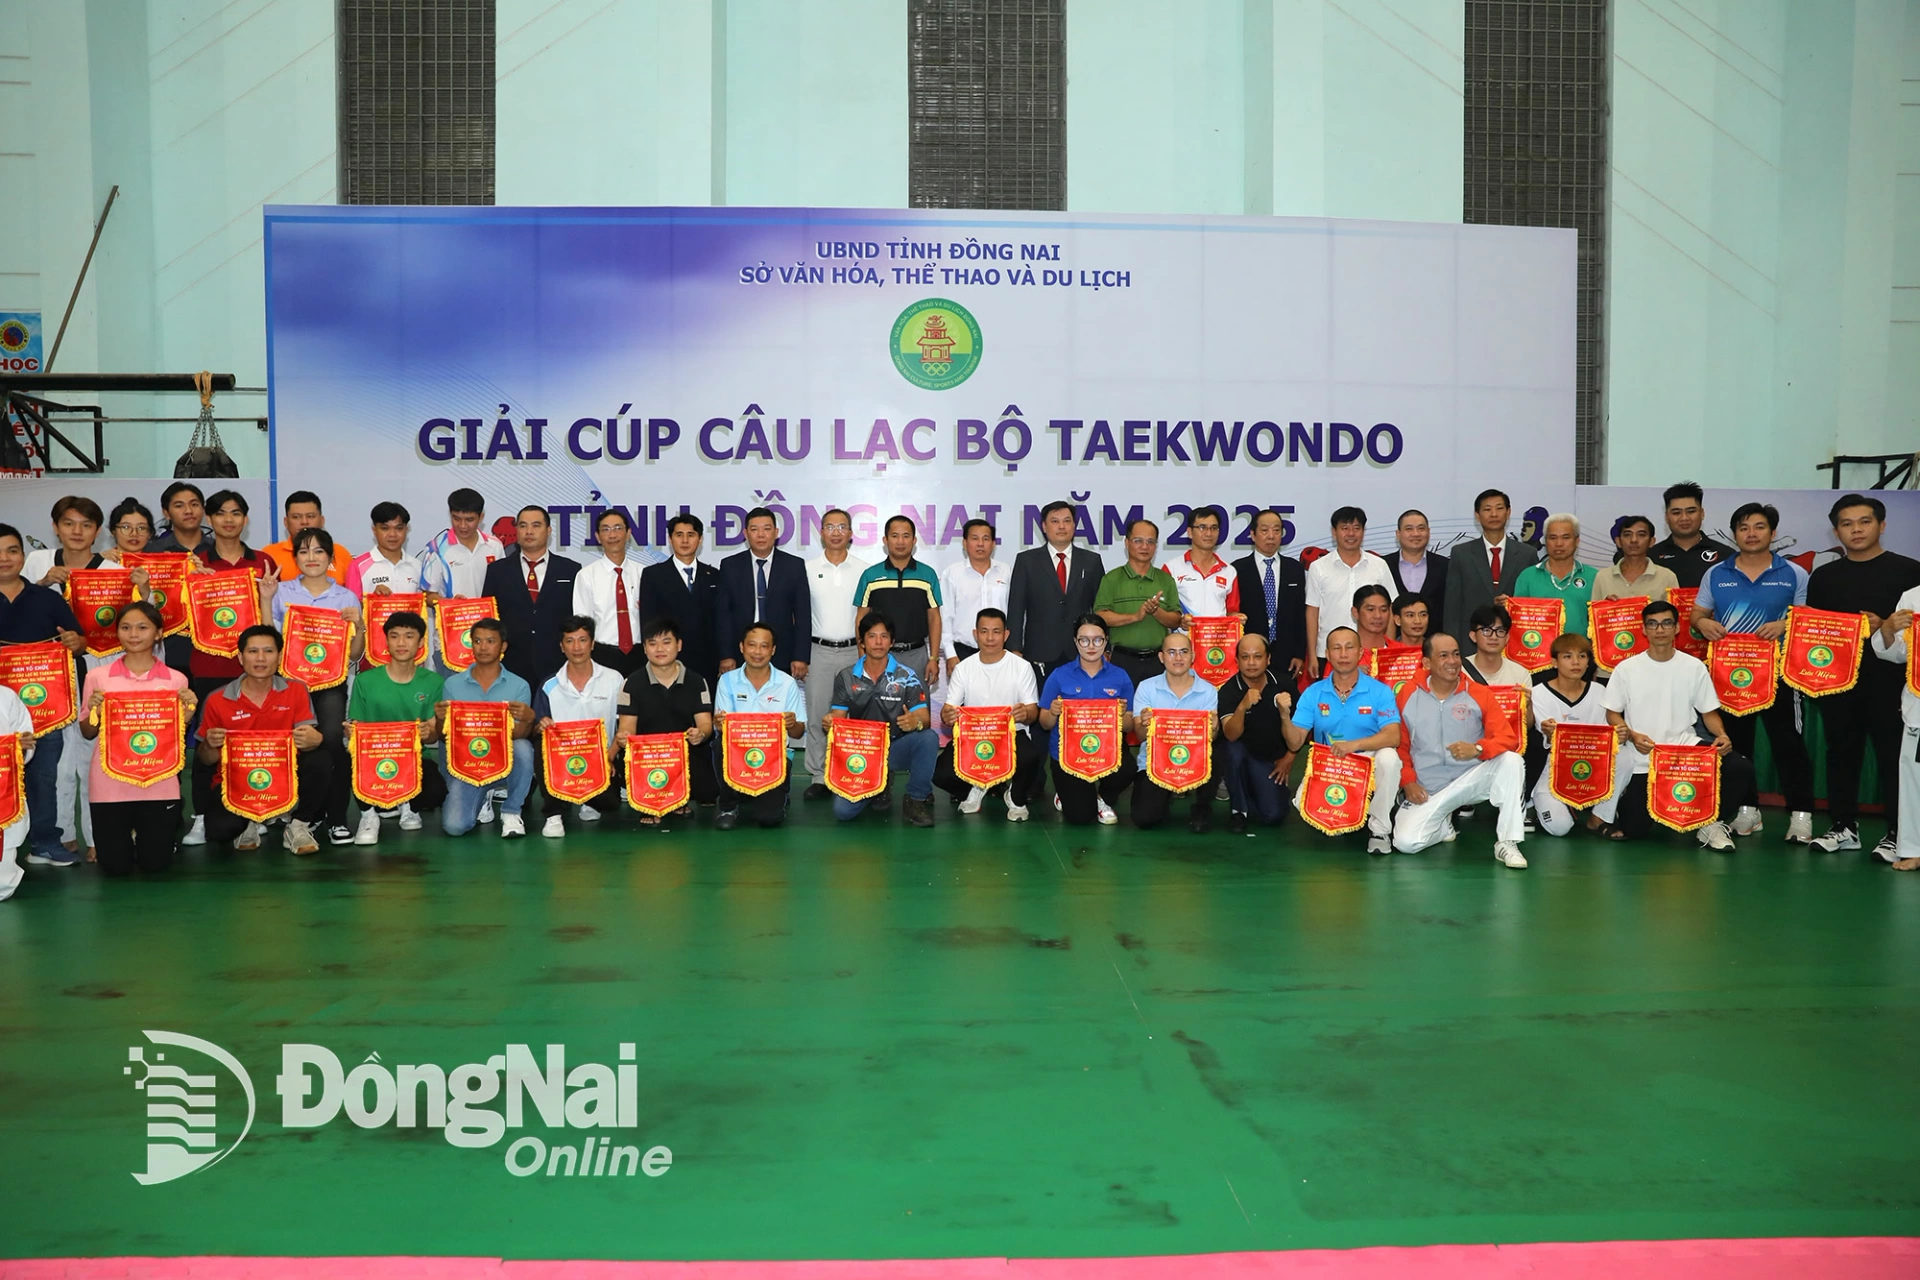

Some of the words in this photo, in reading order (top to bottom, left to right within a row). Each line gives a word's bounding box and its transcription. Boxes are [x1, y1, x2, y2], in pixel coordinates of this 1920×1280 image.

[817, 241, 880, 259] UBND
[886, 237, 942, 259] TỈNH
[949, 238, 1013, 260] ĐỒNG
[1021, 244, 1061, 261] NAI
[741, 261, 773, 283] SỞ
[779, 262, 824, 284] VĂN
[832, 262, 885, 287] HÓA,
[892, 263, 936, 284] THỂ
[940, 268, 1001, 285] THAO
[1007, 264, 1035, 286] VÀ
[1042, 270, 1073, 286] DU
[1080, 270, 1131, 290] LỊCH
[418, 403, 548, 461] GIẢI
[568, 403, 681, 461] CÚP
[700, 403, 812, 461] CÂU
[834, 418, 937, 471] LẠC
[956, 404, 1033, 472] BỘ
[1049, 419, 1404, 465] TAEKWONDO
